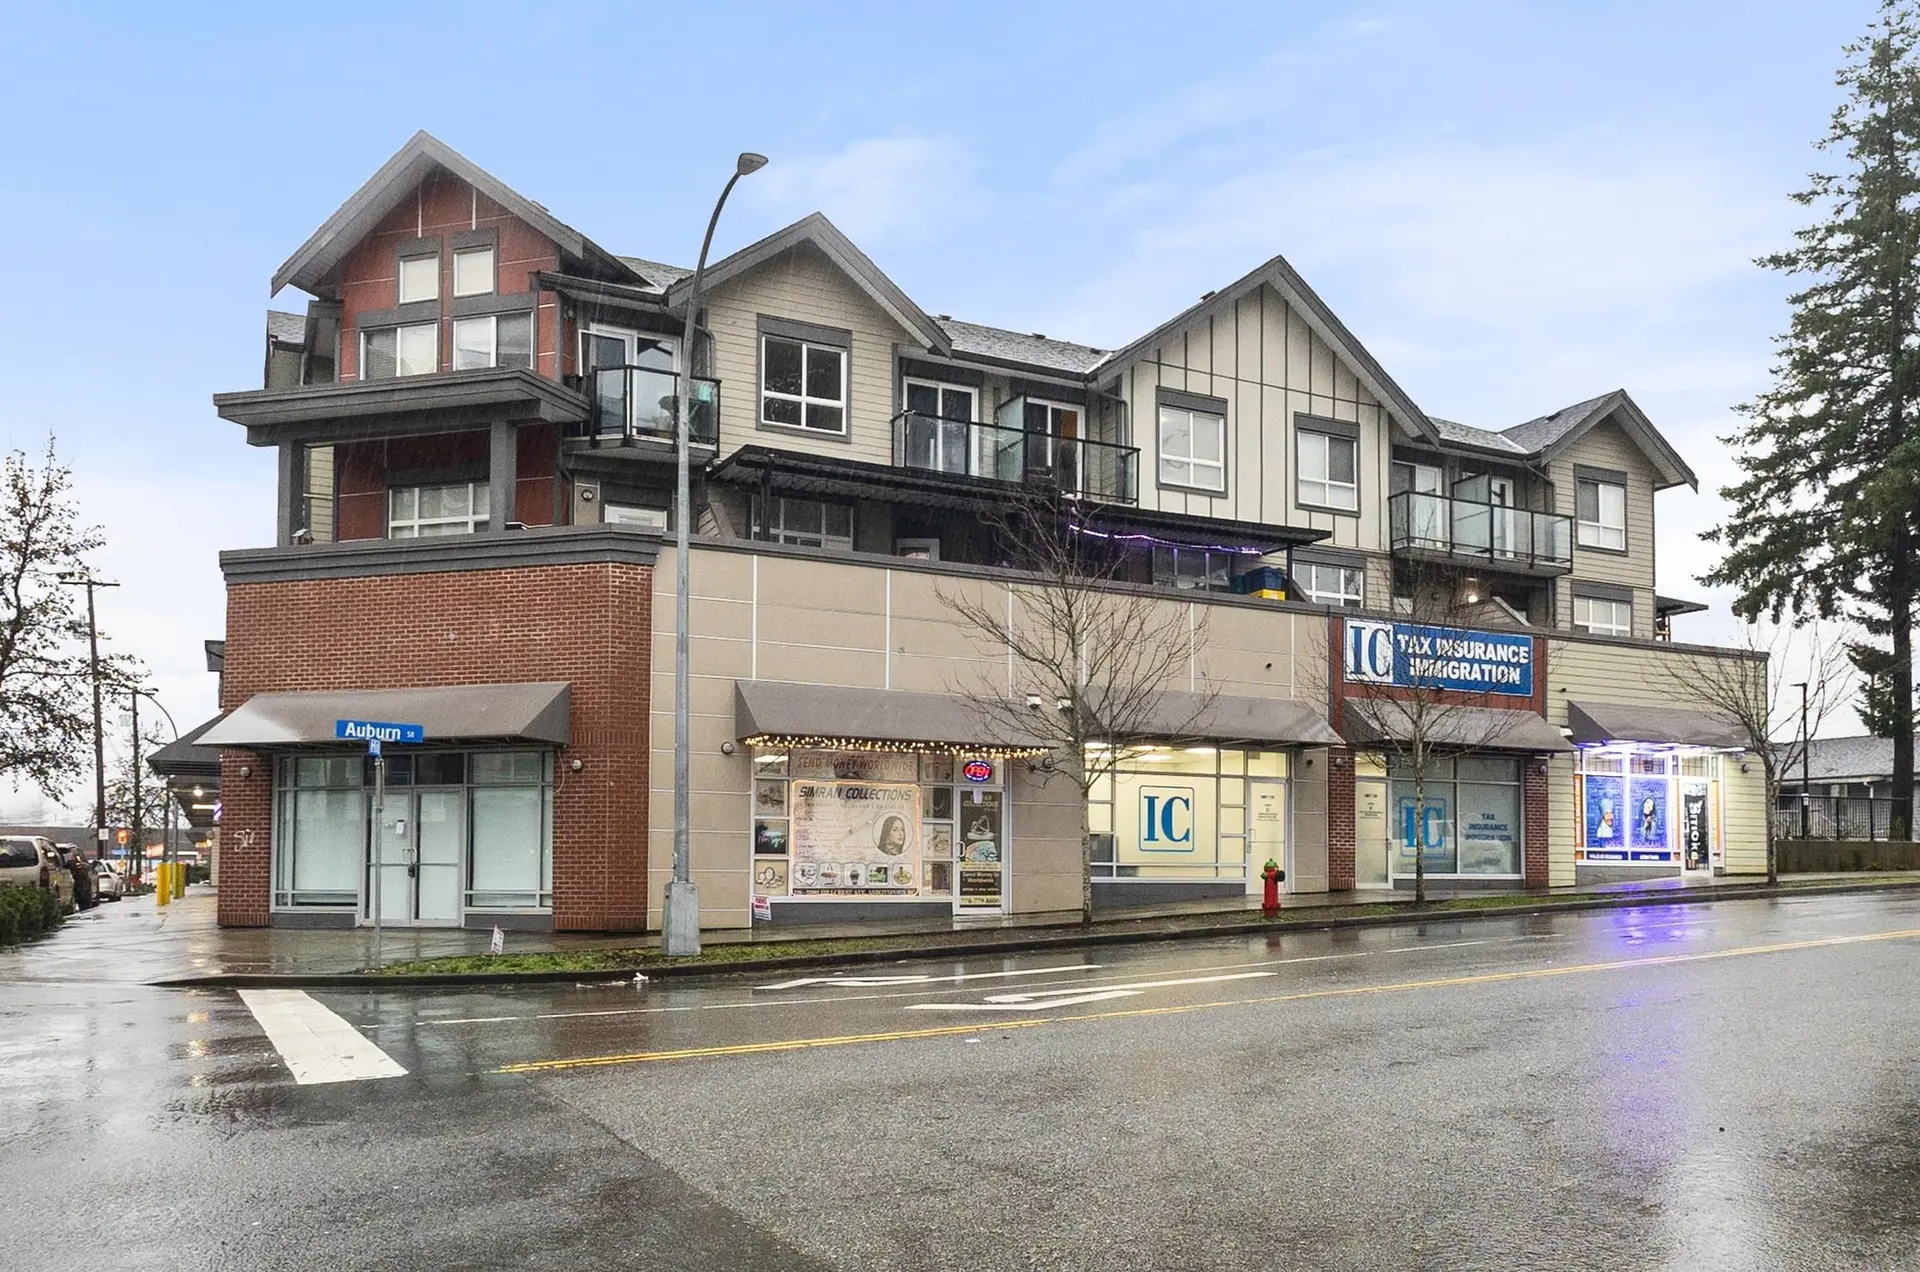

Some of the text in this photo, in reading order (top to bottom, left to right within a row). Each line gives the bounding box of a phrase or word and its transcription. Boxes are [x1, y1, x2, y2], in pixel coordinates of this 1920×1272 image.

[1349, 625, 1392, 677] IC
[1396, 634, 1529, 664] TAX INSURANCE
[1409, 657, 1521, 685] IMMIGRATION
[345, 722, 401, 740] Auburn
[797, 756, 915, 773] SEND MONEY WORLDWIDE
[965, 765, 989, 777] OPEN
[799, 786, 913, 801] SIMRAN COLLECTIONS
[1143, 795, 1190, 842] IC
[1402, 806, 1446, 849] IC
[1468, 823, 1508, 831] INSURANCE
